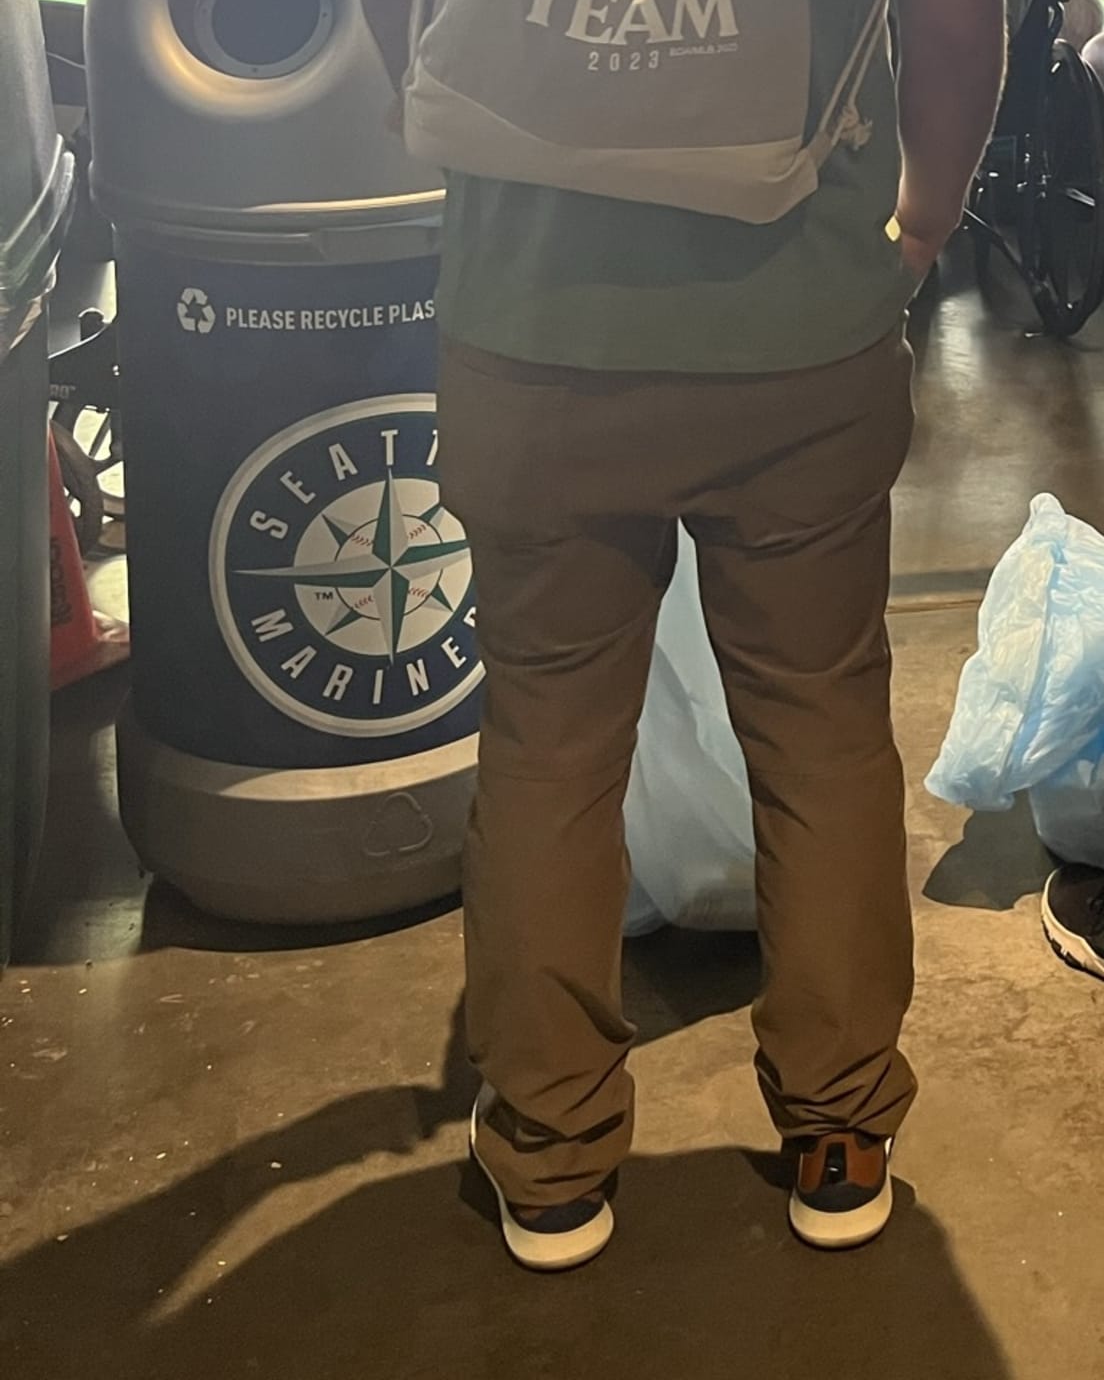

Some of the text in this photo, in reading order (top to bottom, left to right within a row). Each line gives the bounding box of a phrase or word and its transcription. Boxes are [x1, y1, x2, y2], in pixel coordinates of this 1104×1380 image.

[588, 51, 660, 71] 2023
[226, 299, 436, 330] PLEASE RECYCLE PLAS
